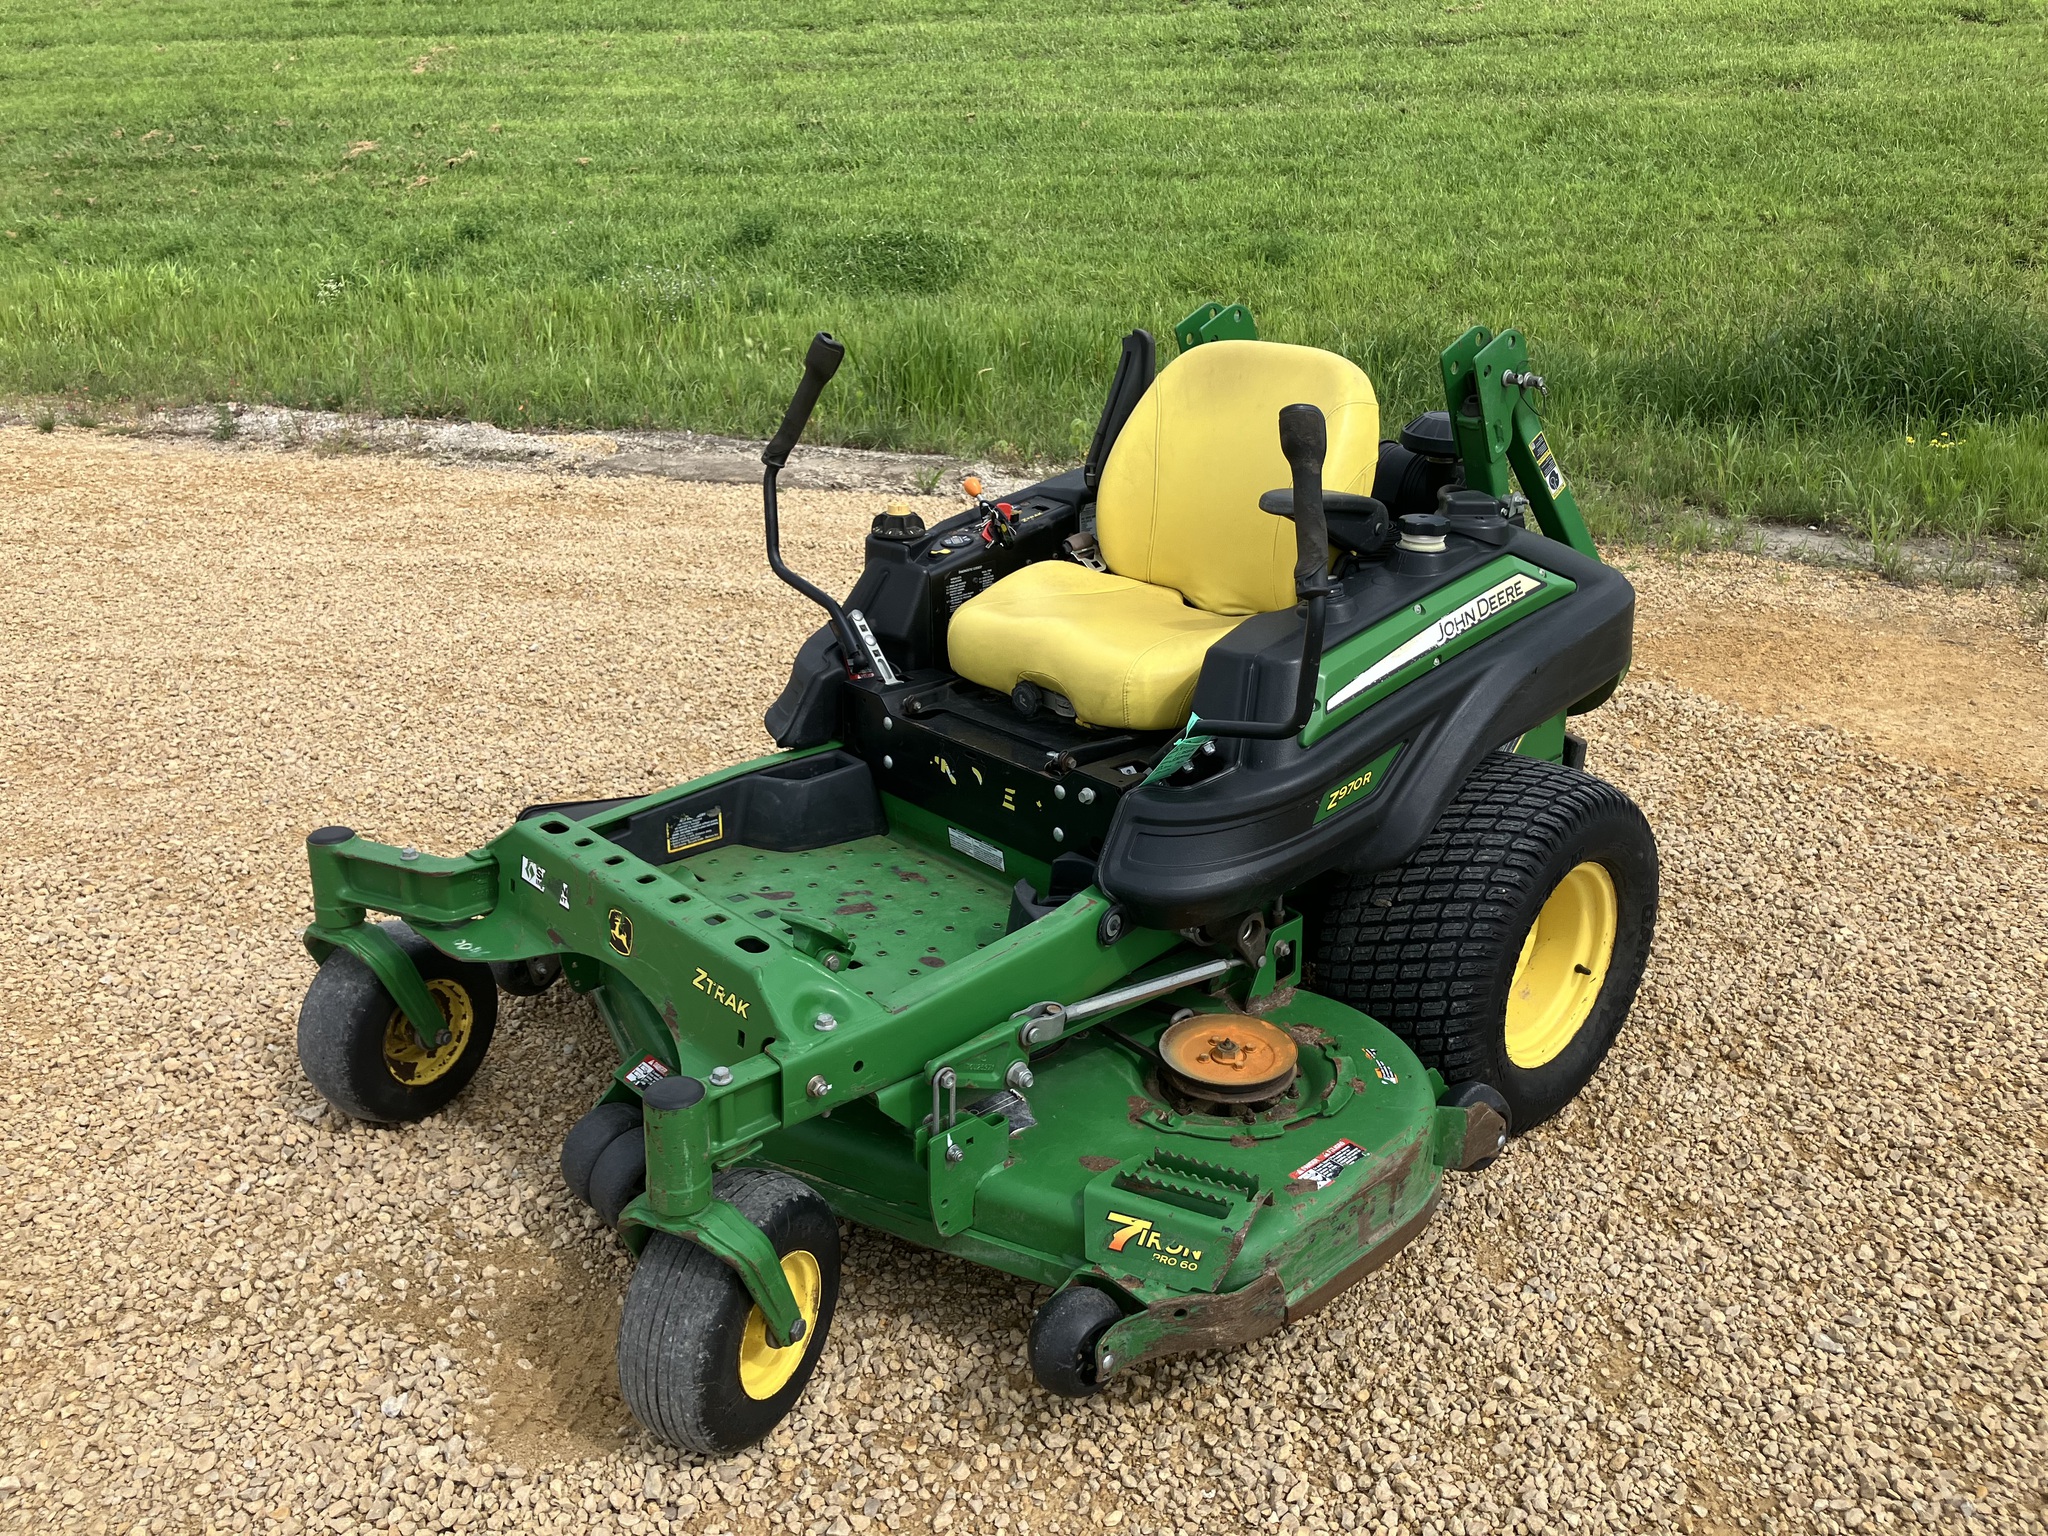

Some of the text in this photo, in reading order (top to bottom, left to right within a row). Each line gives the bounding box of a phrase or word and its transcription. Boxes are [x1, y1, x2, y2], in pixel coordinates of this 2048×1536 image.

[1437, 580, 1524, 643] JOHN DEERE
[1326, 771, 1372, 811] Z970R
[692, 966, 751, 1019] ZTRAK
[1152, 1253, 1198, 1271] PRO 60
